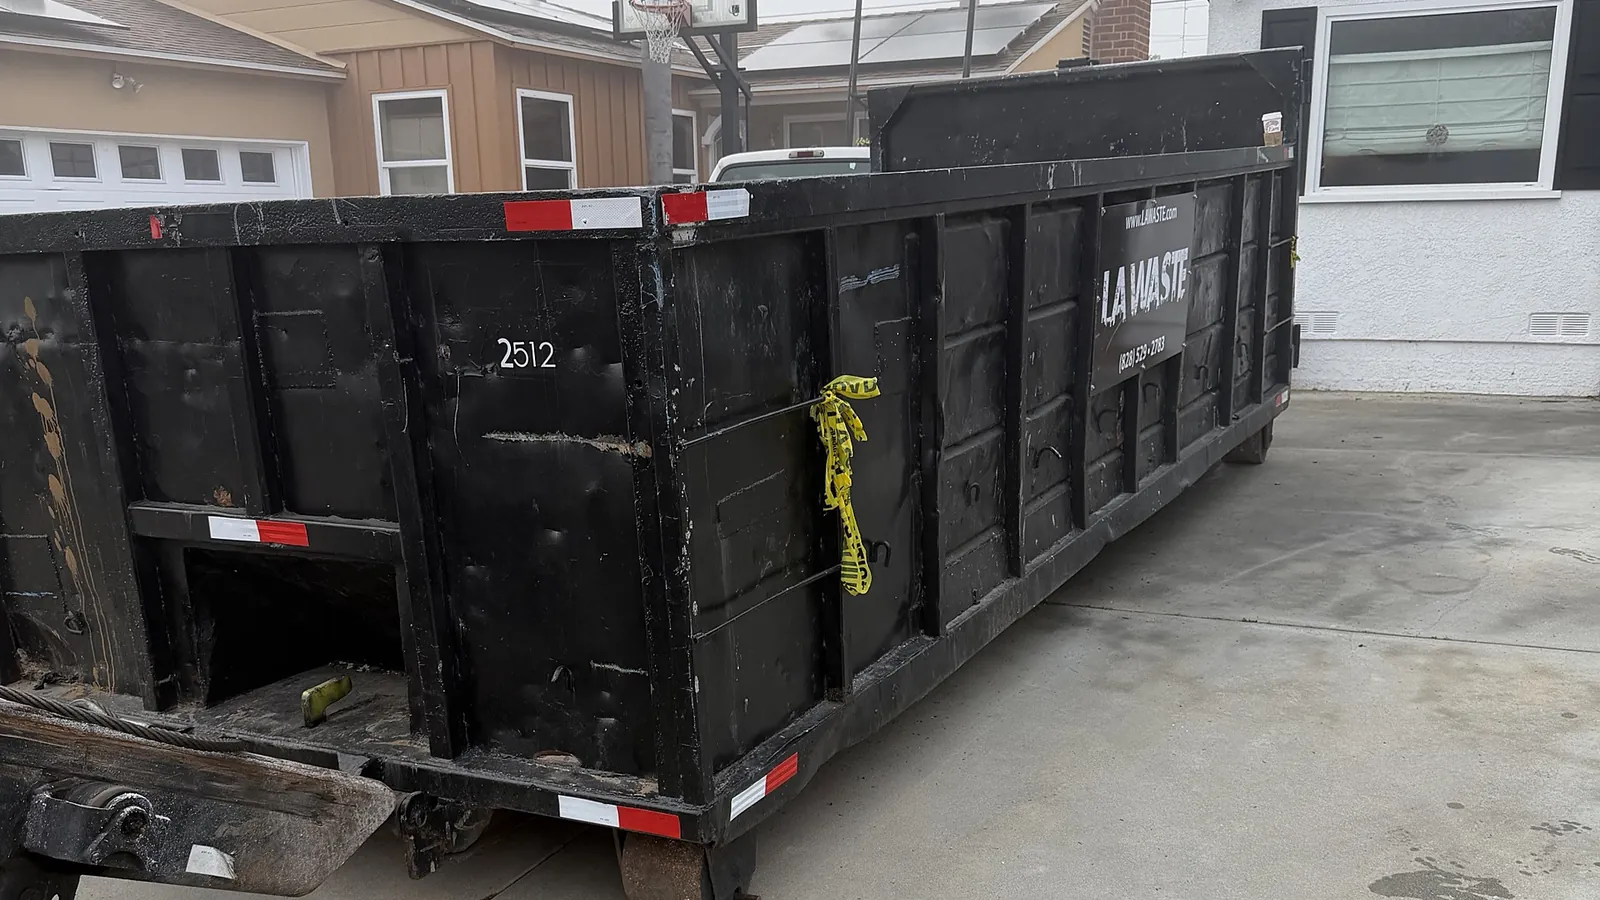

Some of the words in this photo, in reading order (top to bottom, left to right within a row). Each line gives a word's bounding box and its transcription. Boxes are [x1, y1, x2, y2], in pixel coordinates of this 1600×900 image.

[1125, 205, 1178, 229] www.LAWASTE.com
[1101, 266, 1127, 327] LA
[1130, 247, 1189, 316] WASTE
[497, 337, 556, 368] 2512
